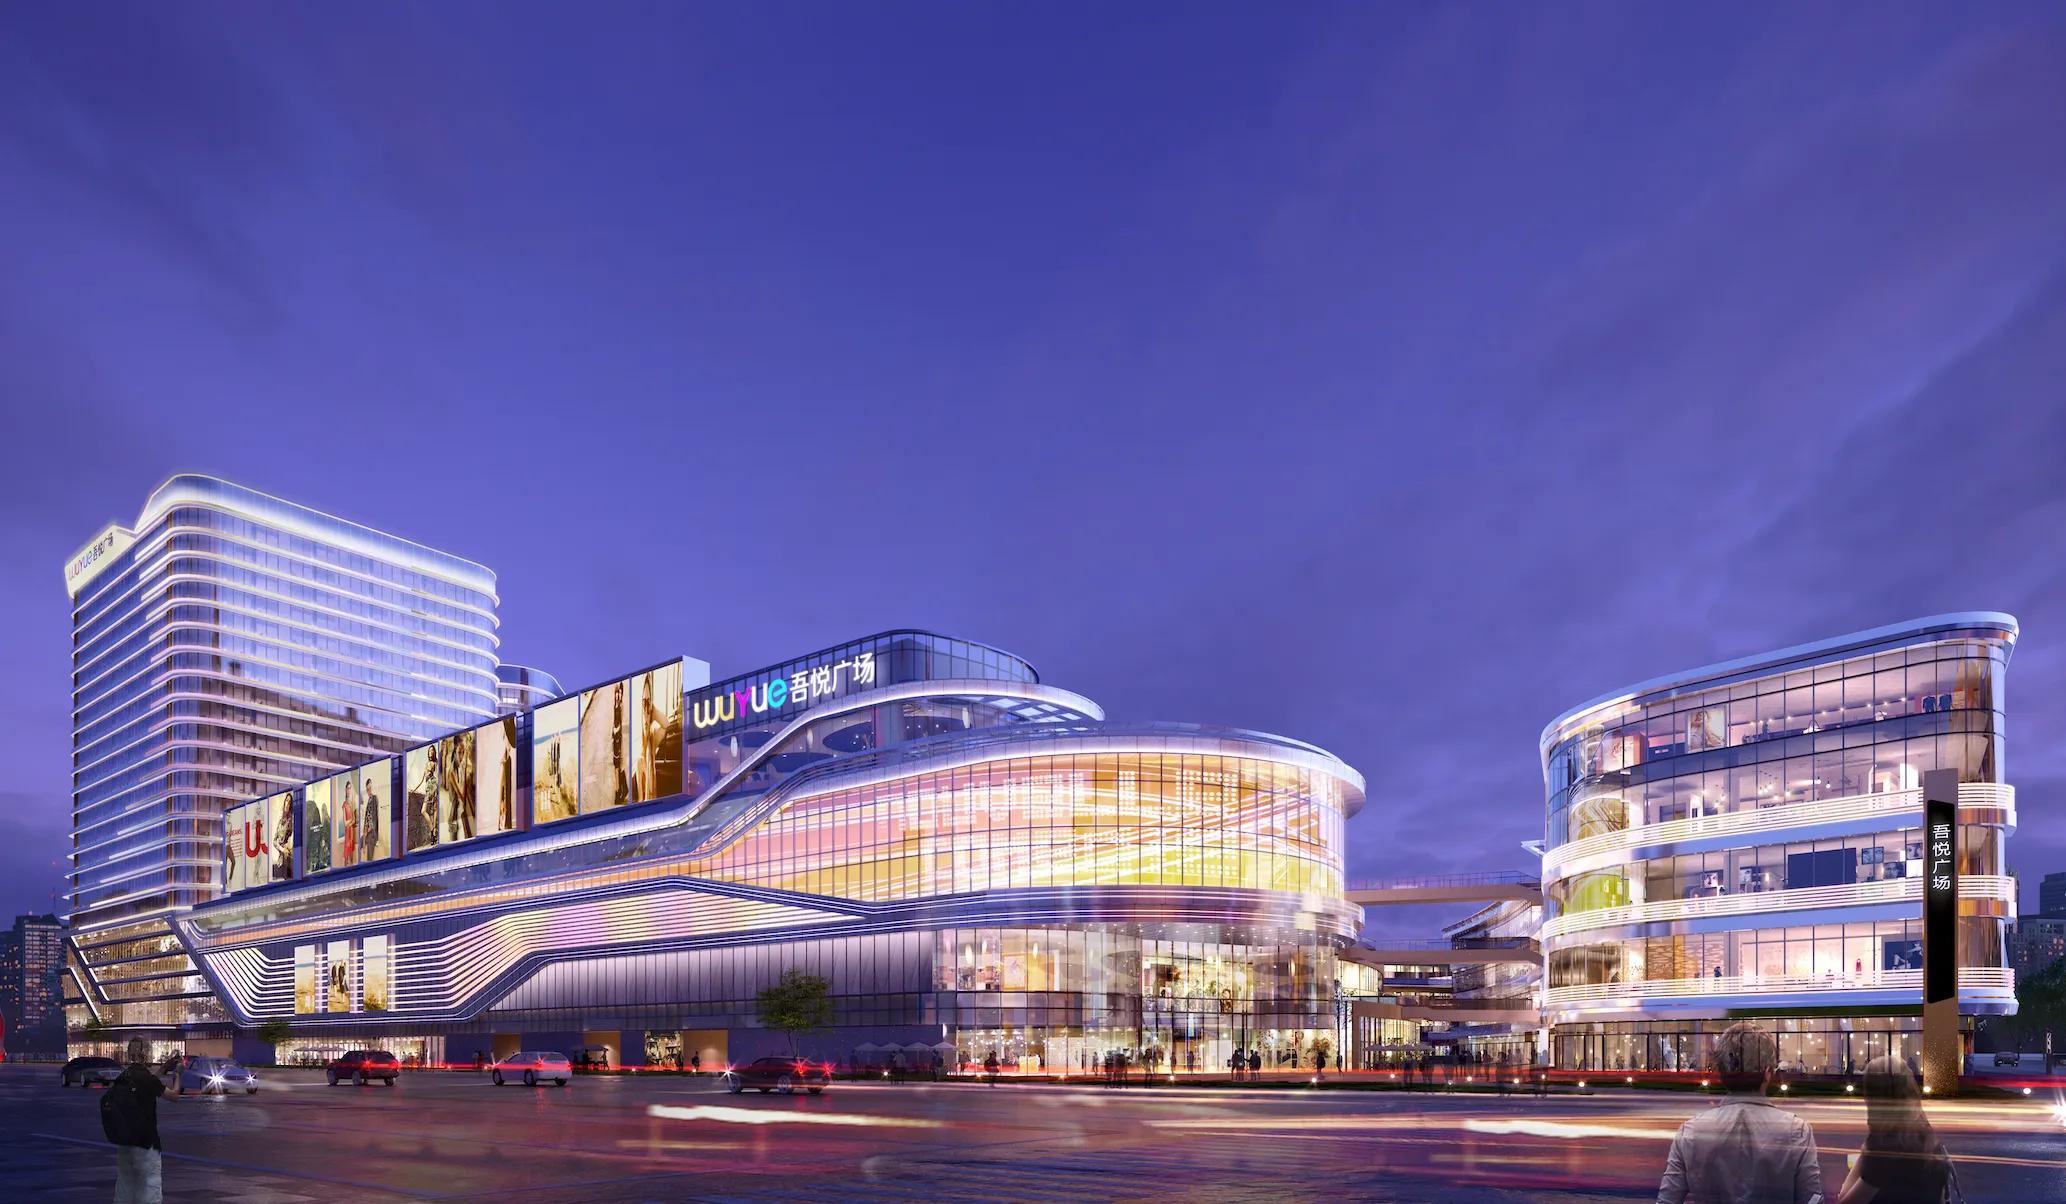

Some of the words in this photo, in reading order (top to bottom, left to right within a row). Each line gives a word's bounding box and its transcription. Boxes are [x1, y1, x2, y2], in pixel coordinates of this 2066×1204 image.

[789, 652, 875, 704] 吾悦广场
[1932, 823, 1952, 891] 吾悦广场
